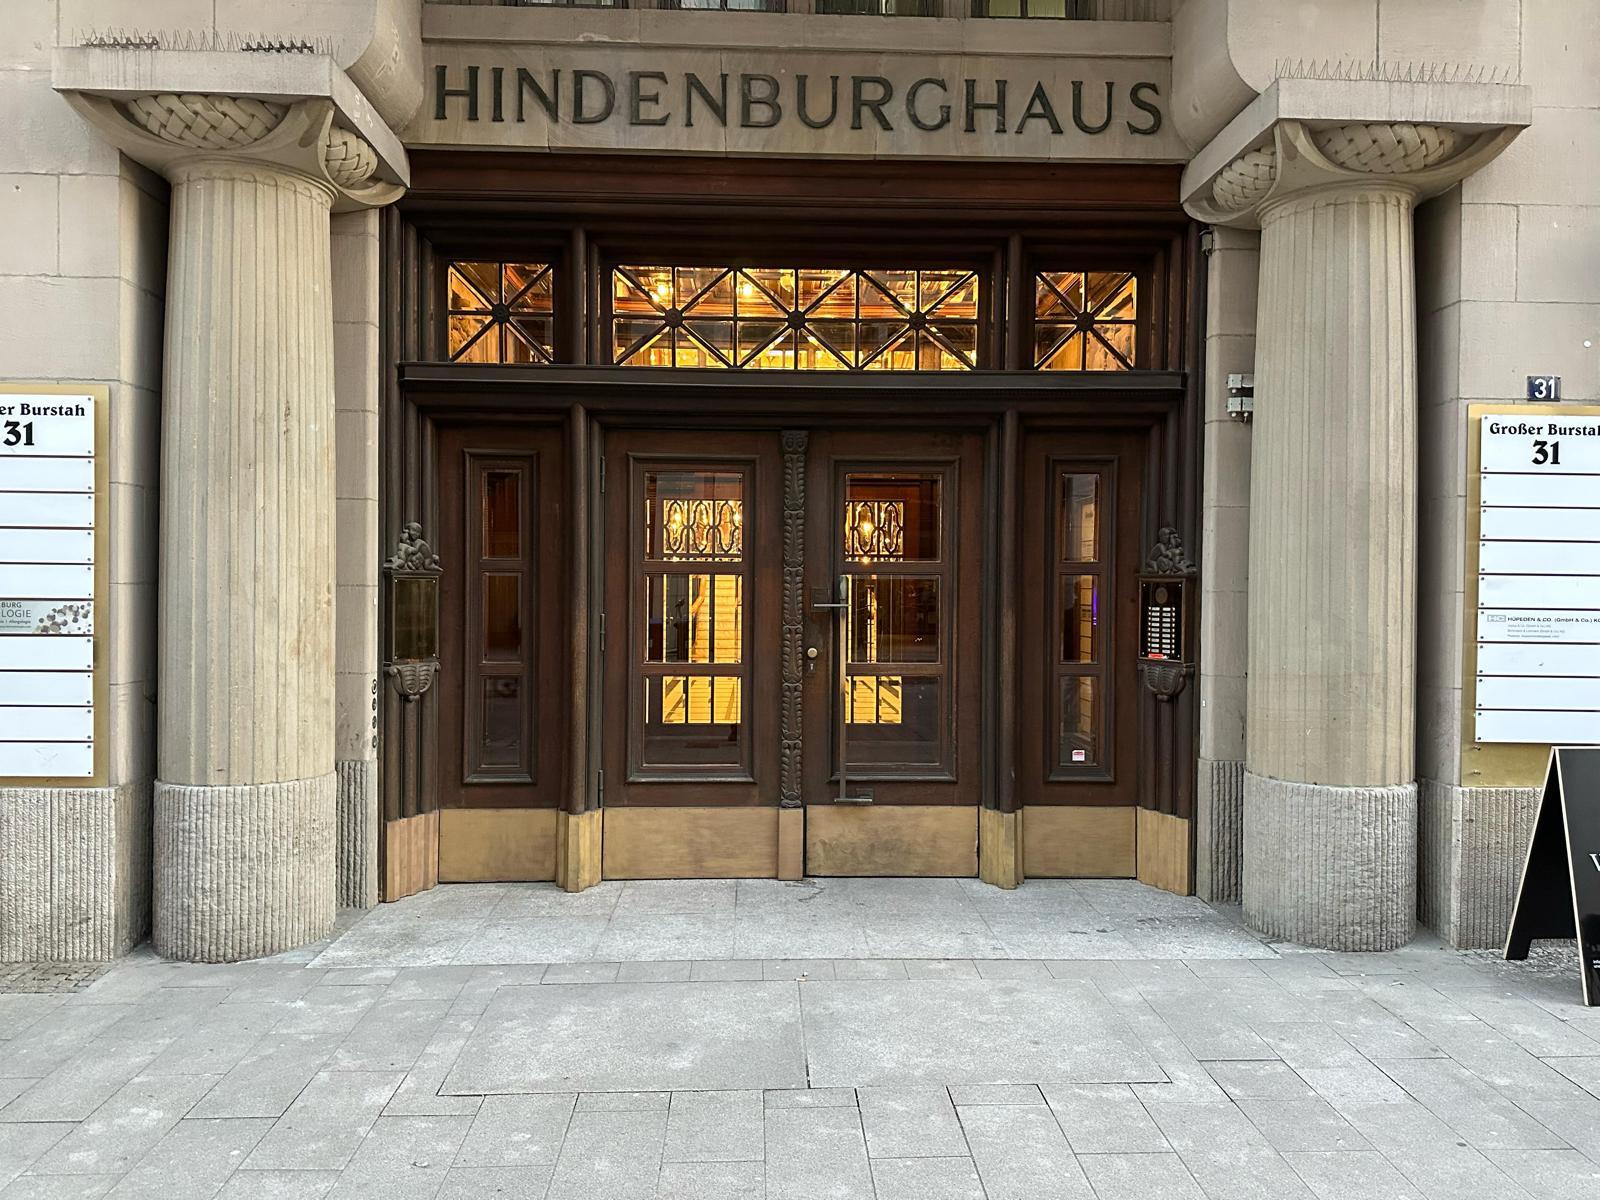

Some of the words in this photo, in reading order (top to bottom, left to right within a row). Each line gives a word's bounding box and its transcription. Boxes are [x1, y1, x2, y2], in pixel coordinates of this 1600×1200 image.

[433, 64, 1163, 136] HINDENBURGHAUS
[1534, 378, 1555, 399] 31
[20, 403, 86, 417] Burstah
[3, 420, 35, 447] 31
[1489, 422, 1543, 435] Großer
[1531, 439, 1561, 465] 31
[1, 609, 32, 618] LOGIE
